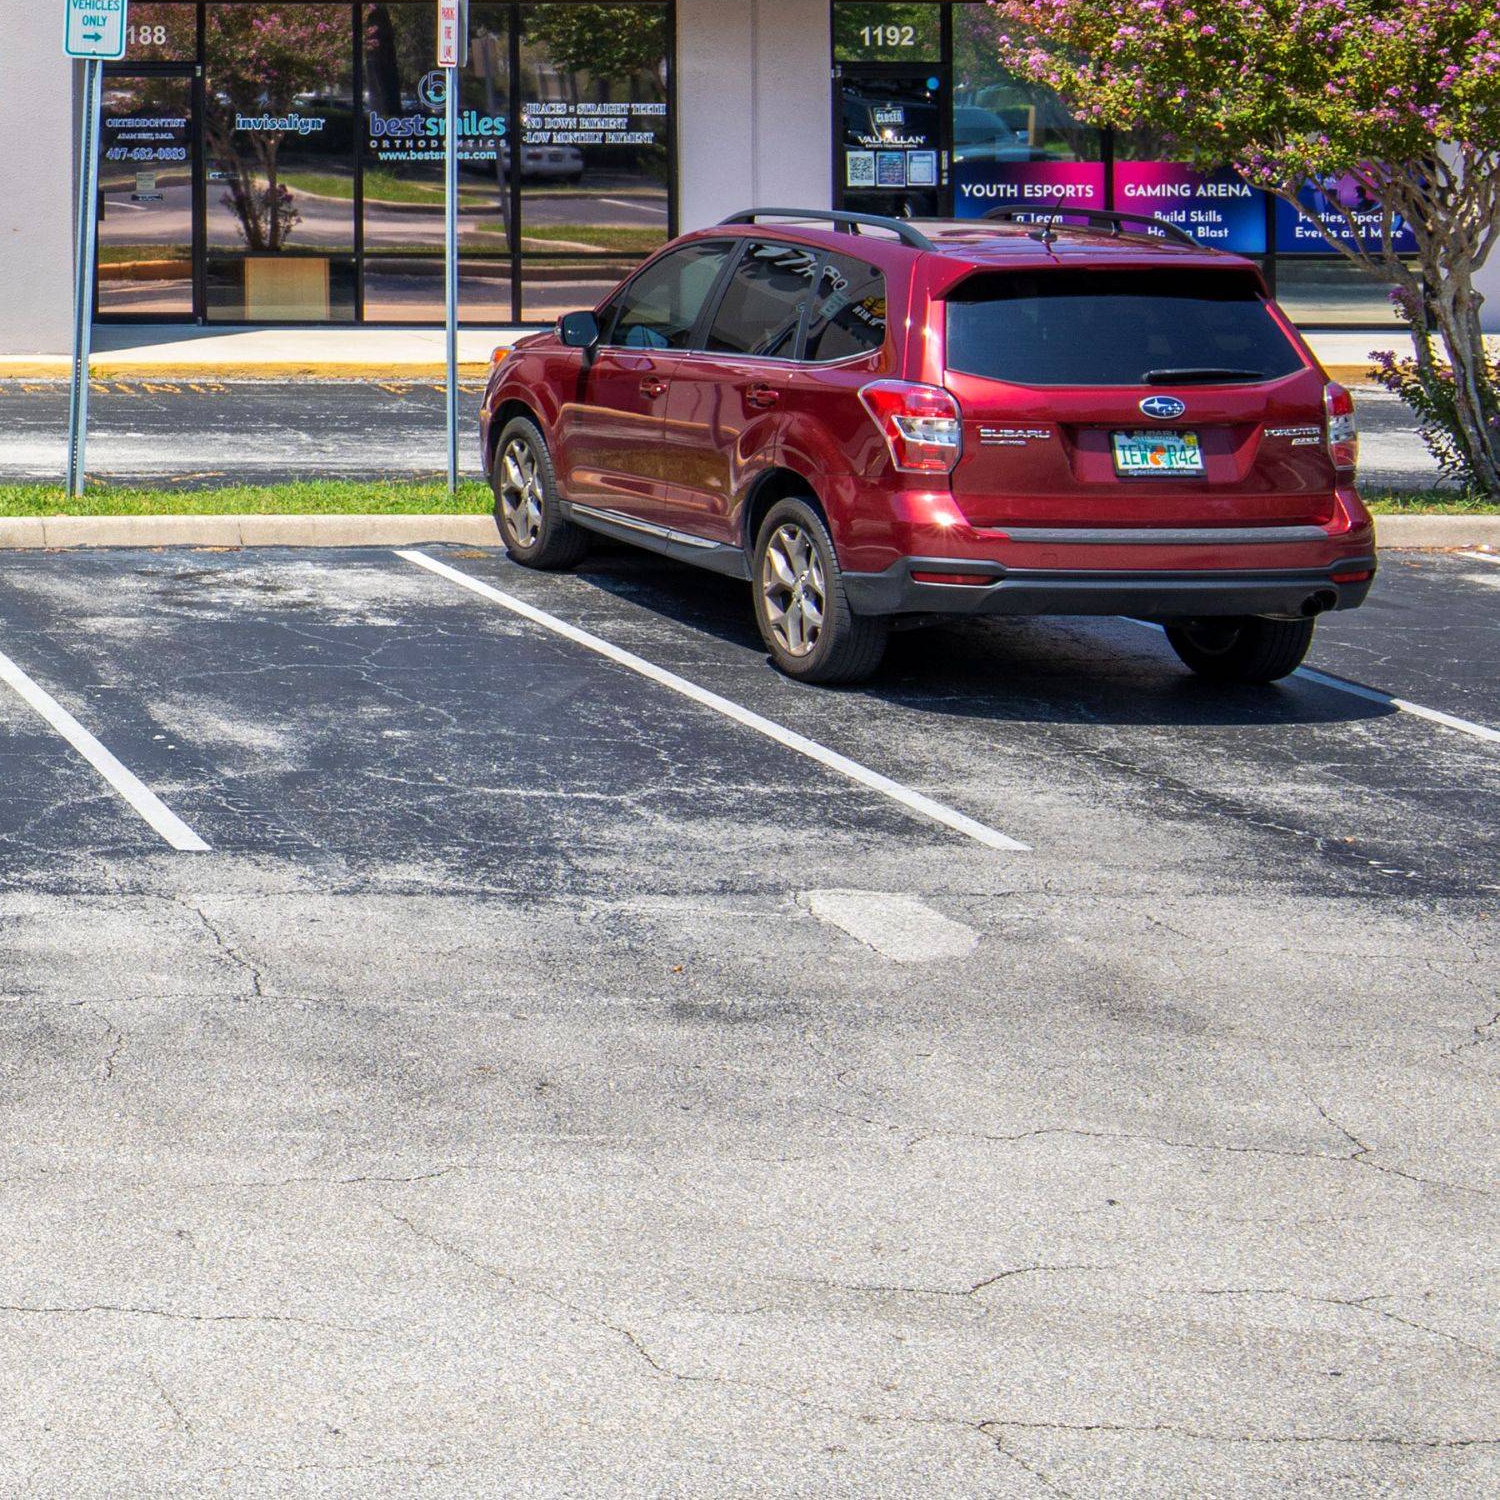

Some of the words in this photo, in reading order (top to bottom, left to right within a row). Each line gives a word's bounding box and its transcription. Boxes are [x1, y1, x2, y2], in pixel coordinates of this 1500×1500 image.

[82, 14, 107, 27] ONLY
[126, 25, 166, 45] 188
[860, 26, 915, 46] 1192
[544, 117, 577, 129] DOWN
[579, 117, 628, 129] PAYMENT
[876, 112, 903, 123] CLOSED
[236, 114, 325, 135] invisalign
[552, 132, 603, 143] MONTHLY
[605, 132, 654, 143] PAYMENT
[858, 135, 924, 144] VALHALLAN
[378, 150, 497, 161] www.bestses.com
[961, 184, 1018, 198] YOUTH
[1024, 184, 1094, 198] ESPORTS
[1124, 184, 1190, 198] GAMING
[1196, 184, 1252, 198] ARENA
[1154, 210, 1186, 223] Build
[1190, 210, 1222, 222] Skills
[1351, 211, 1395, 225] Specil
[1197, 226, 1229, 238] Blast
[1341, 227, 1366, 238] ad
[1370, 227, 1404, 238] Mre
[980, 429, 1050, 438] SUBARU
[1264, 427, 1321, 436] FORESTER
[1119, 444, 1149, 465] IEW
[1167, 444, 1199, 465] R42
